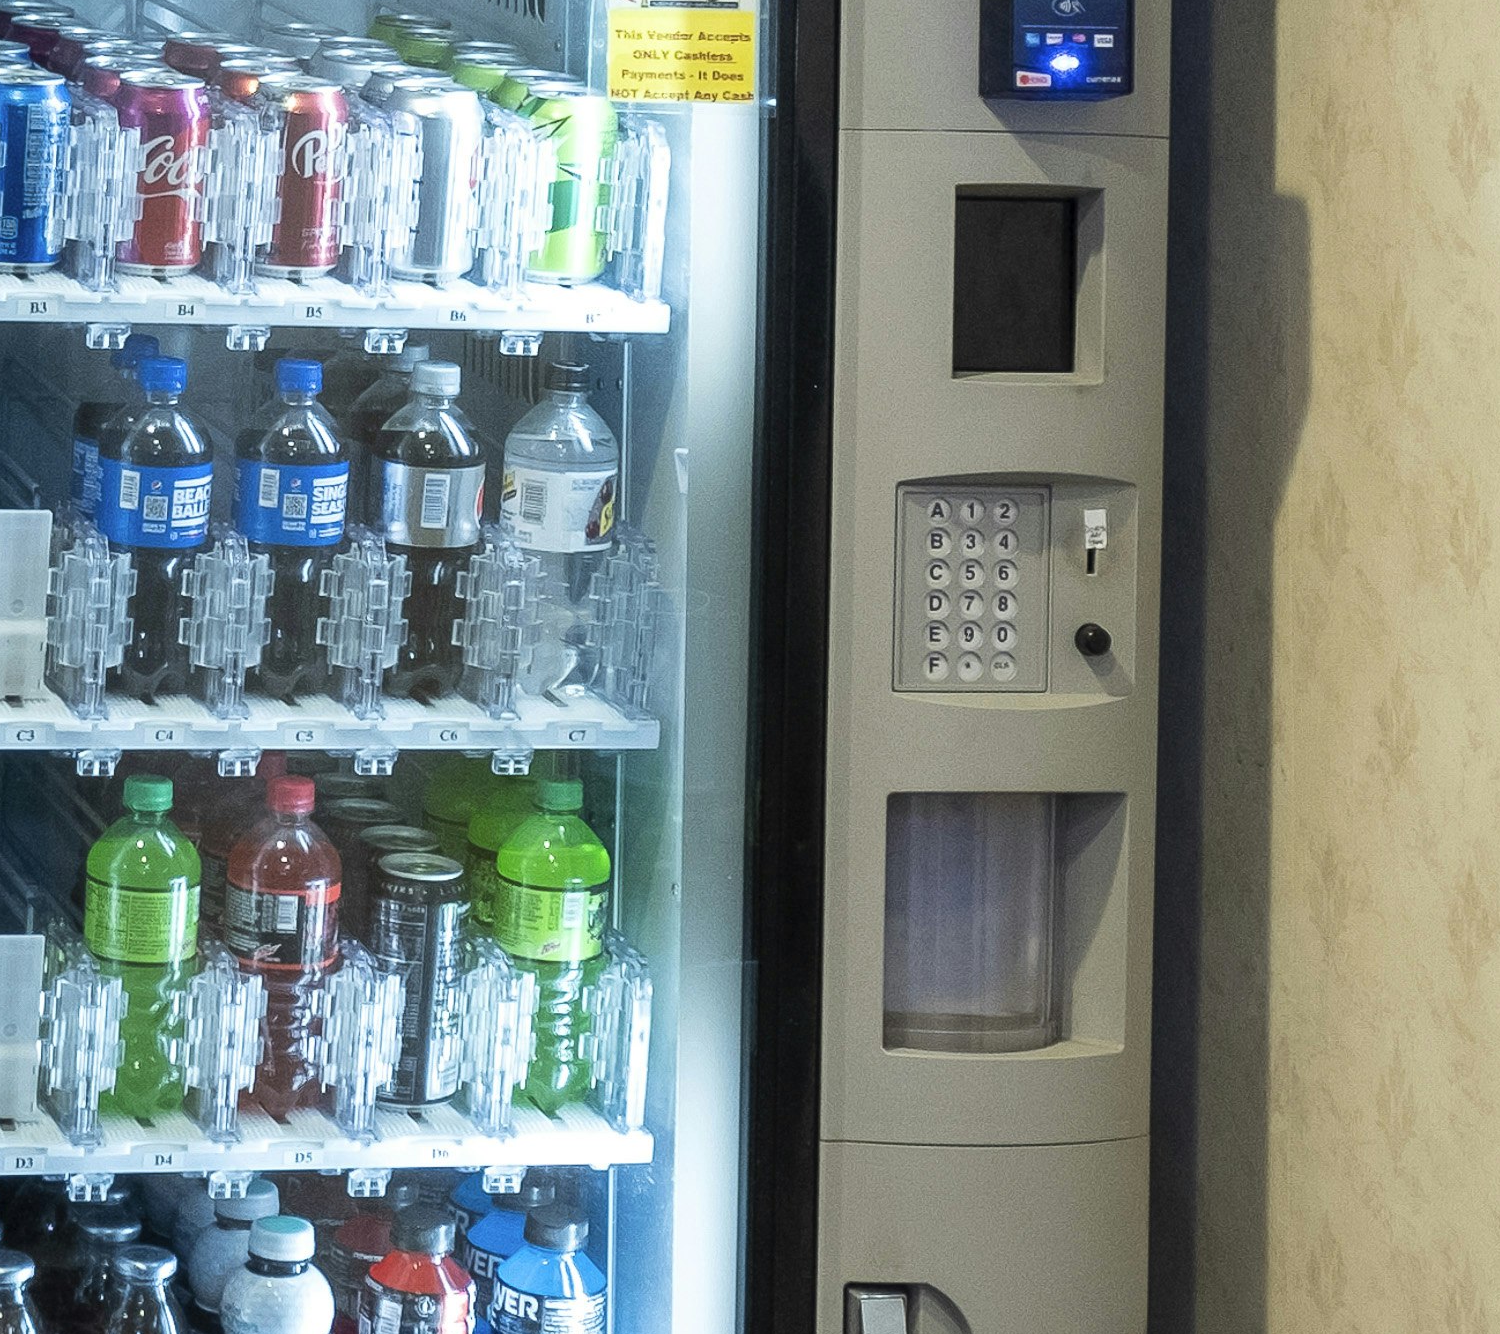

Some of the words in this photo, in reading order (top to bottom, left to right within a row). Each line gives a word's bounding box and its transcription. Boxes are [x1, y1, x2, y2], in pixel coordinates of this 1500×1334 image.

[615, 29, 642, 41] This
[648, 30, 692, 41] Vendor
[698, 31, 751, 44] Accepts
[633, 50, 670, 60] ONLY
[674, 50, 733, 62] Cashless
[621, 69, 686, 82] Payments
[698, 71, 708, 80] It
[712, 71, 744, 81] Does
[611, 88, 639, 98] NOT
[643, 89, 689, 102] Accept
[694, 91, 718, 102] Any
[722, 91, 754, 101] Cash
[29, 301, 48, 314] B3
[177, 304, 195, 317] B4
[305, 306, 323, 319] B5
[449, 309, 467, 322] B6
[173, 485, 212, 504] BEAC
[313, 485, 347, 501] SING
[930, 503, 945, 518] A
[968, 503, 975, 518] 1
[999, 504, 1010, 518] 2
[930, 533, 943, 549] B
[966, 534, 976, 549] 3
[999, 534, 1009, 549] 4
[929, 564, 943, 580] C
[965, 565, 976, 580] 5
[998, 565, 1009, 580] 6
[929, 596, 942, 611] D
[964, 596, 975, 611] 7
[998, 596, 1008, 611] 8
[929, 626, 941, 642] E
[964, 626, 974, 642] 9
[997, 627, 1008, 642] 0
[929, 657, 940, 673] F
[16, 729, 35, 742] C3
[155, 729, 174, 742] C4
[295, 729, 315, 742] C5
[439, 729, 458, 742] C6
[568, 729, 587, 742] C7
[15, 1156, 34, 1169] D3
[155, 1153, 173, 1167] D4
[294, 1152, 314, 1165] D5
